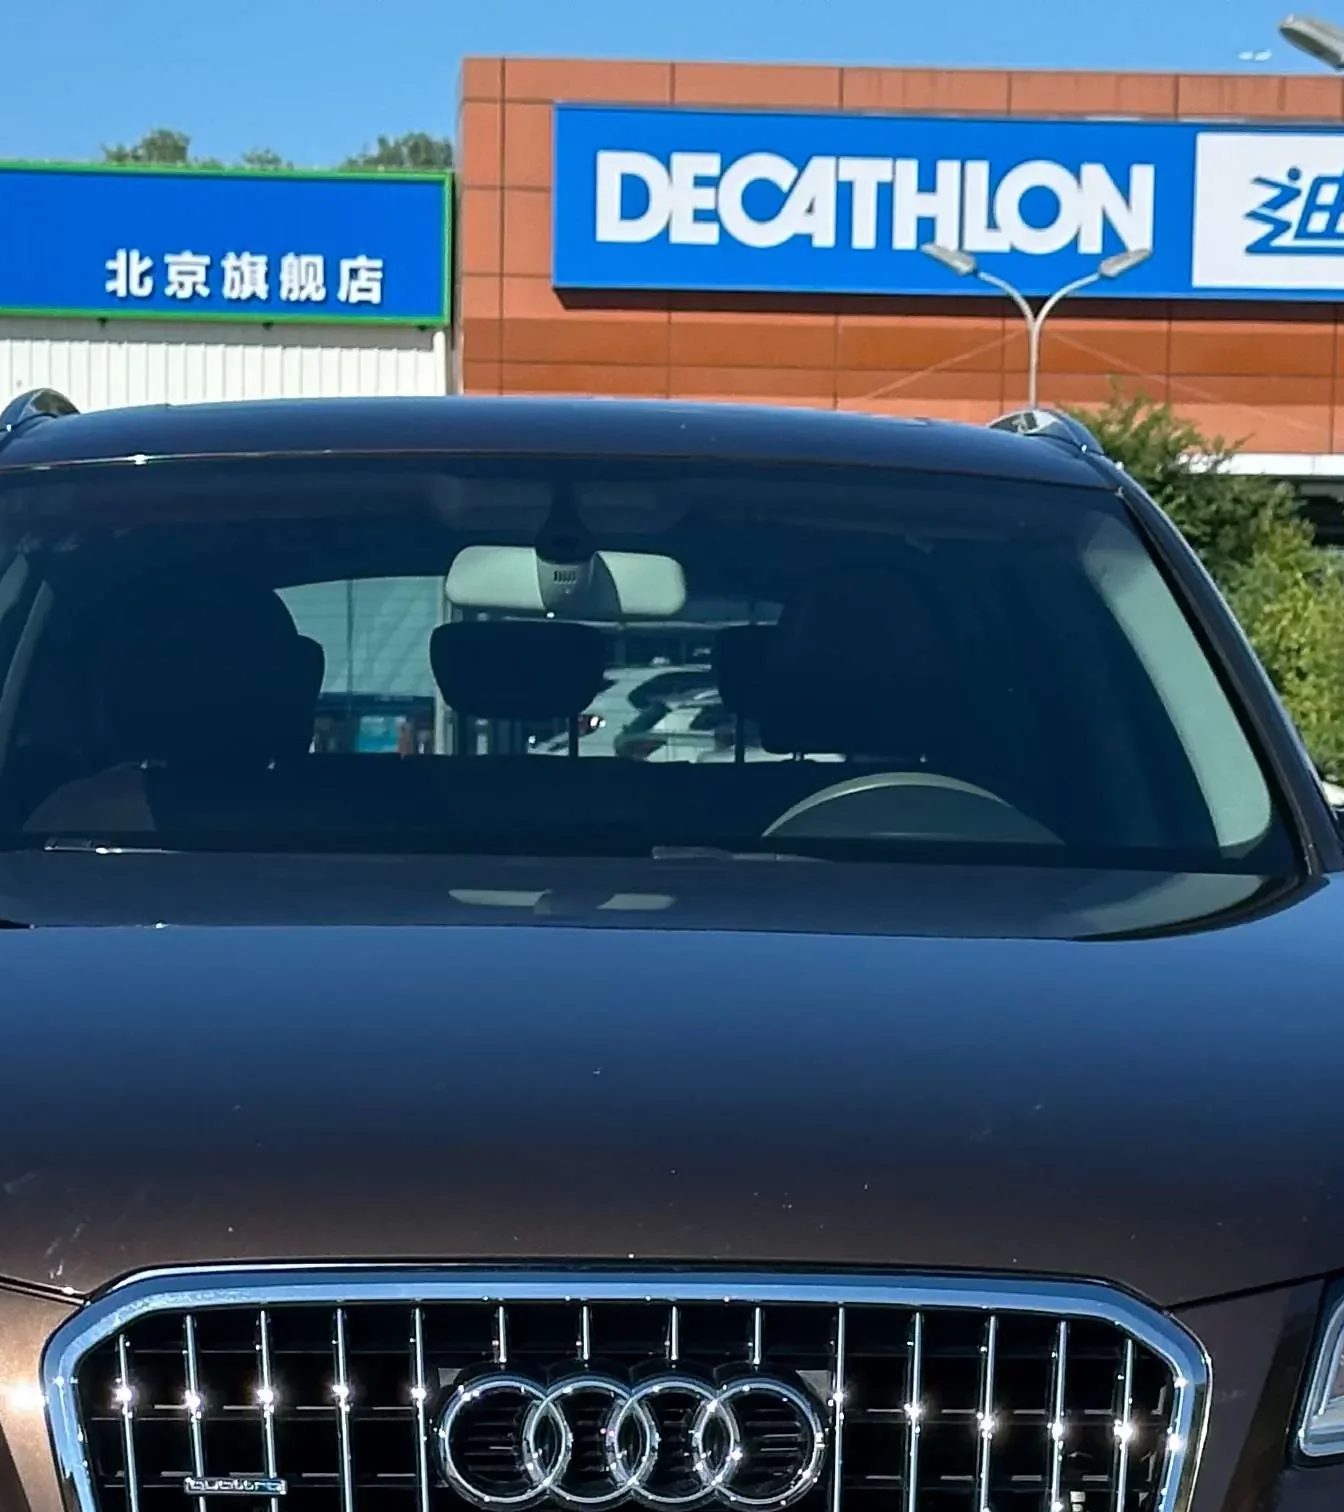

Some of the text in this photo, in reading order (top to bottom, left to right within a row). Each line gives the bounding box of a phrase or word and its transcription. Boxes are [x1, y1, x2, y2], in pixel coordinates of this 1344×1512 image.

[596, 150, 1155, 255] DECATHLON
[105, 248, 384, 304] 北京旗舰店
